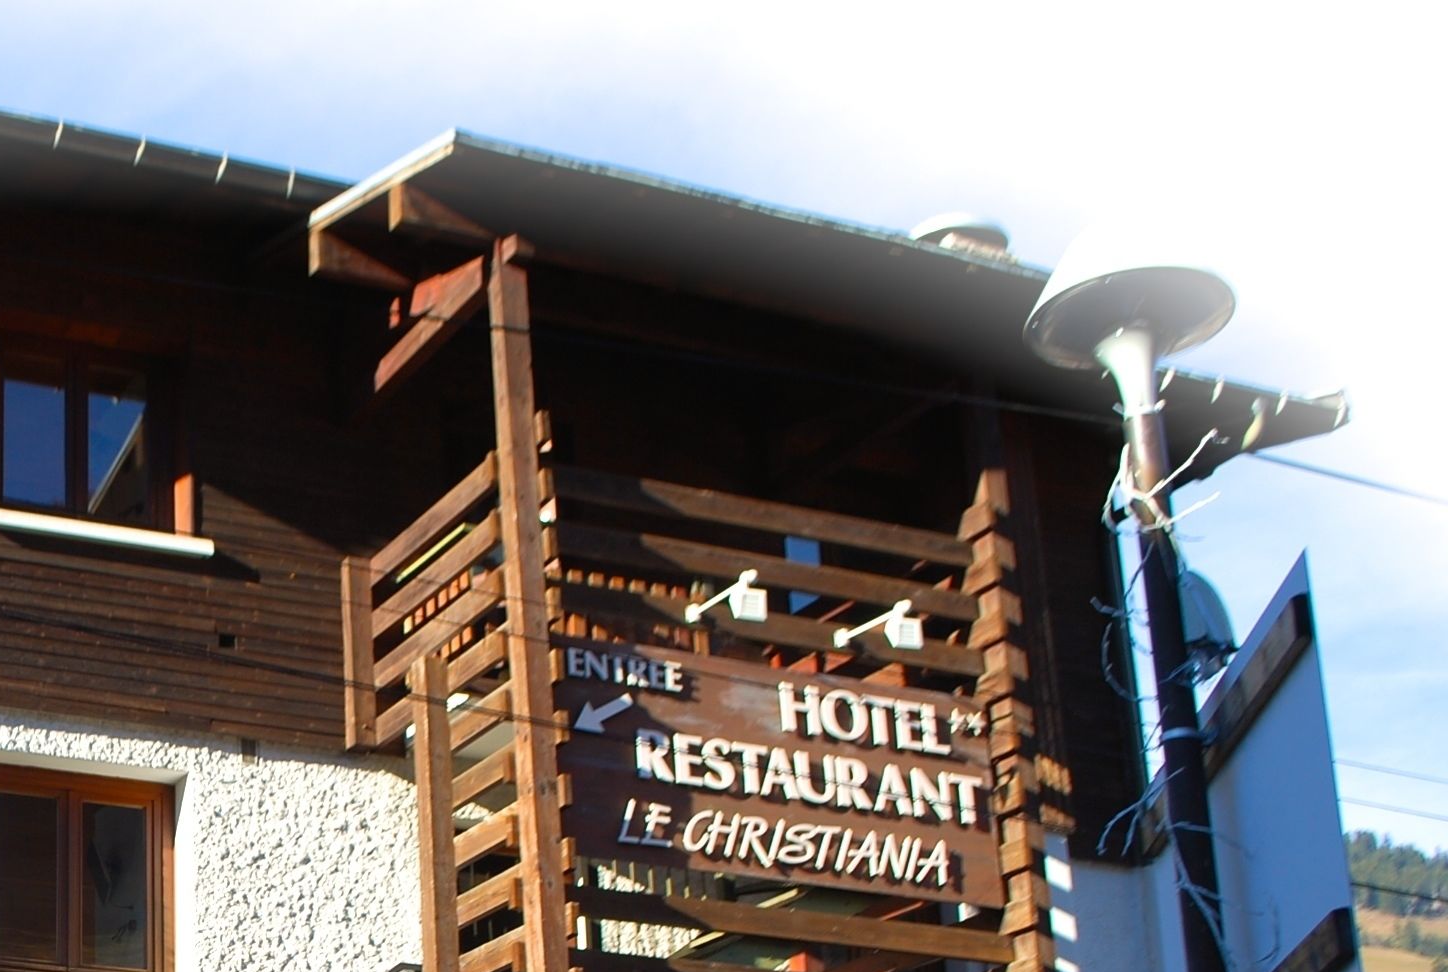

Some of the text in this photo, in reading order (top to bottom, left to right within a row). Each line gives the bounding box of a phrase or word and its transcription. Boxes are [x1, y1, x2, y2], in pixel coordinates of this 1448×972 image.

[778, 681, 951, 755] HOTEL
[635, 728, 983, 825] RESTAURANT
[617, 798, 948, 887] LE CHRISTIANIA
